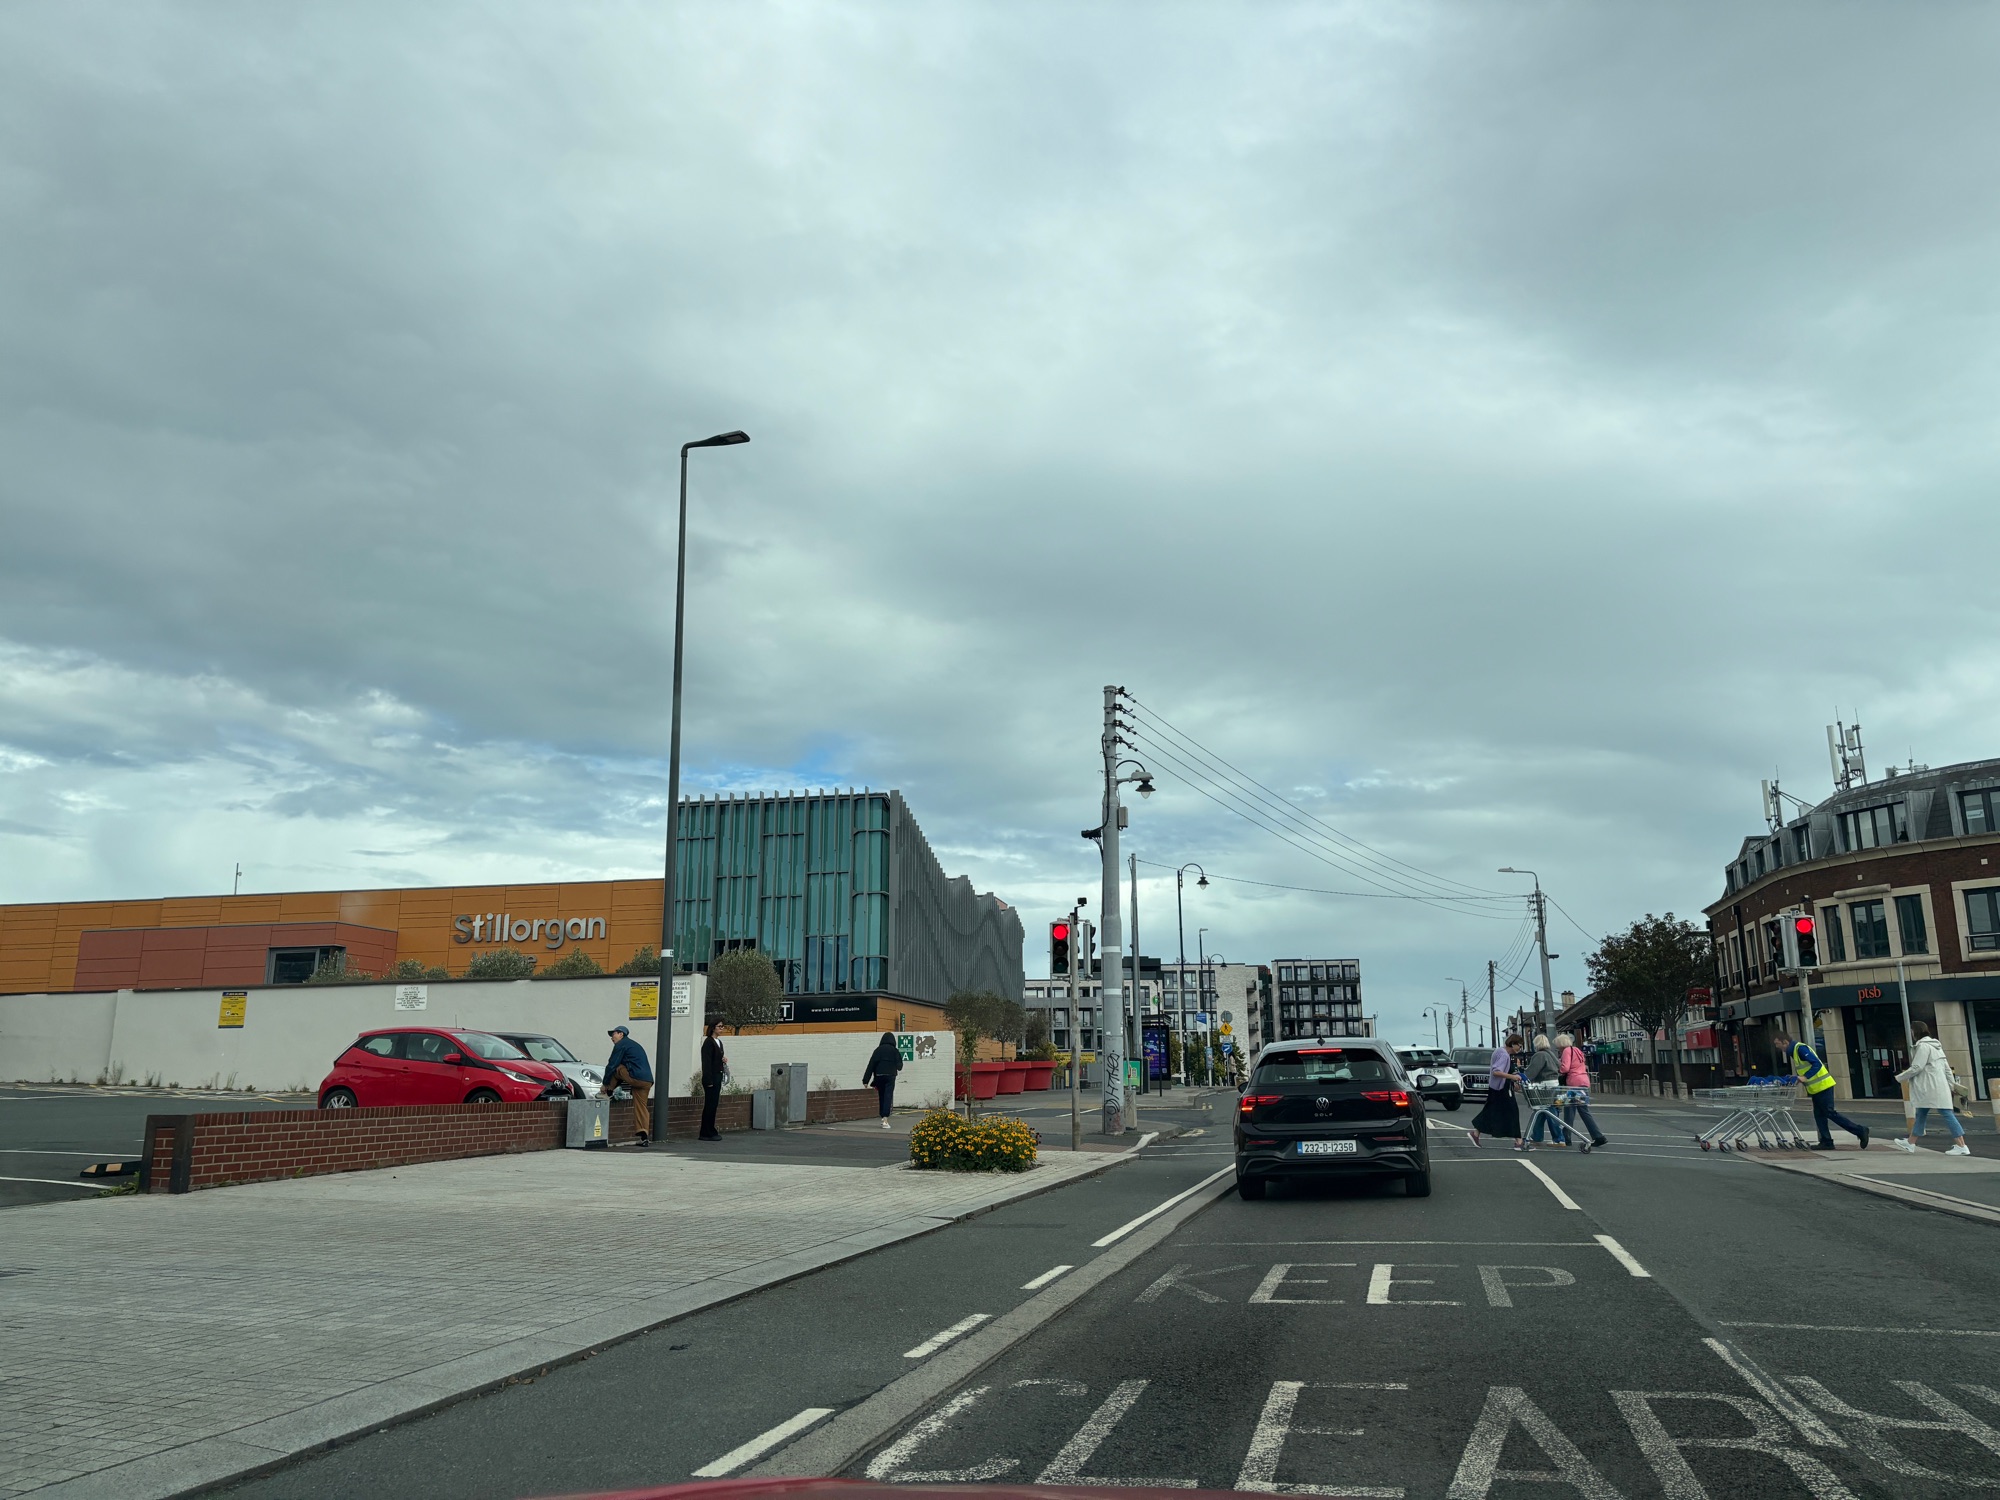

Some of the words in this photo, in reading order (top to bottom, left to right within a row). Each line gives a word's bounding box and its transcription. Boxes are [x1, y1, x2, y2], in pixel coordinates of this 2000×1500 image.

[453, 912, 607, 949] Stillorgan
[1858, 985, 1882, 1002] ptsb
[902, 1052, 909, 1060] A
[1304, 1142, 1354, 1153] 232-D-12358
[1134, 1262, 1577, 1308] KEEP
[864, 1377, 1862, 1500] CLEAR
